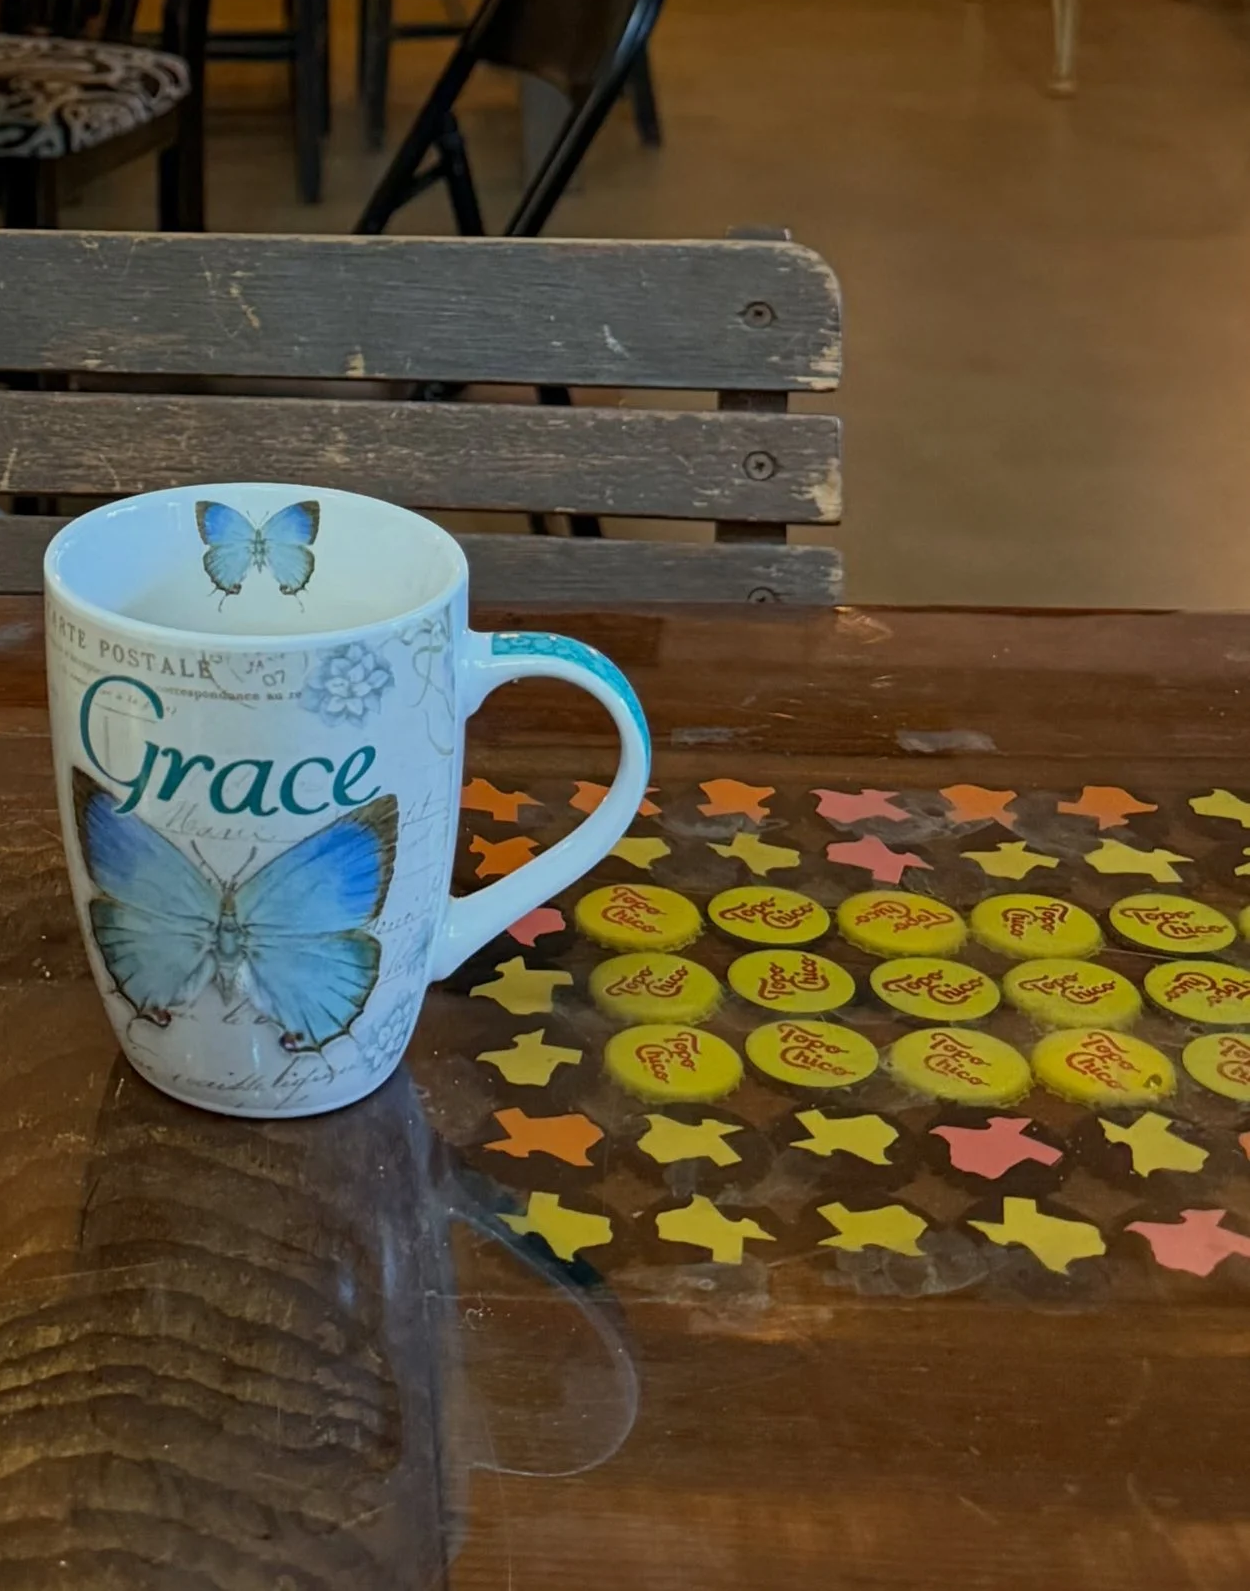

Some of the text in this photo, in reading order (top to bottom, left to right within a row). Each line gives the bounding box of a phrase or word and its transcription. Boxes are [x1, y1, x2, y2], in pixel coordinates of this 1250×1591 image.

[52, 610, 86, 649] ARTE
[100, 639, 213, 679] POSTALE
[79, 675, 381, 817] Grace
[611, 886, 667, 915] Topo
[718, 897, 776, 922] Topo
[762, 902, 814, 929] Chico
[855, 901, 911, 926] Chico
[602, 906, 663, 934] Chico
[893, 909, 954, 933] Topo
[1001, 908, 1037, 940] Chico
[1034, 903, 1069, 935] Topo
[1119, 907, 1195, 926] Topo
[1156, 921, 1228, 940] Chico
[605, 965, 653, 996] Topo
[646, 965, 689, 998] Chico
[758, 962, 795, 1000] Topo
[789, 954, 830, 992] Chico
[882, 969, 944, 996] Topo
[1018, 972, 1079, 995] Topo
[1164, 971, 1217, 1002] Chico
[927, 977, 985, 1005] Chico
[1061, 981, 1116, 1005] Chico
[664, 1032, 701, 1072] Topo
[777, 1023, 849, 1054] Topo
[930, 1032, 991, 1066] Topo
[1080, 1031, 1141, 1073] Topo
[635, 1044, 675, 1084] Chico
[780, 1045, 856, 1076] Chico
[923, 1053, 991, 1087] Chico
[1065, 1051, 1130, 1092] Chico
